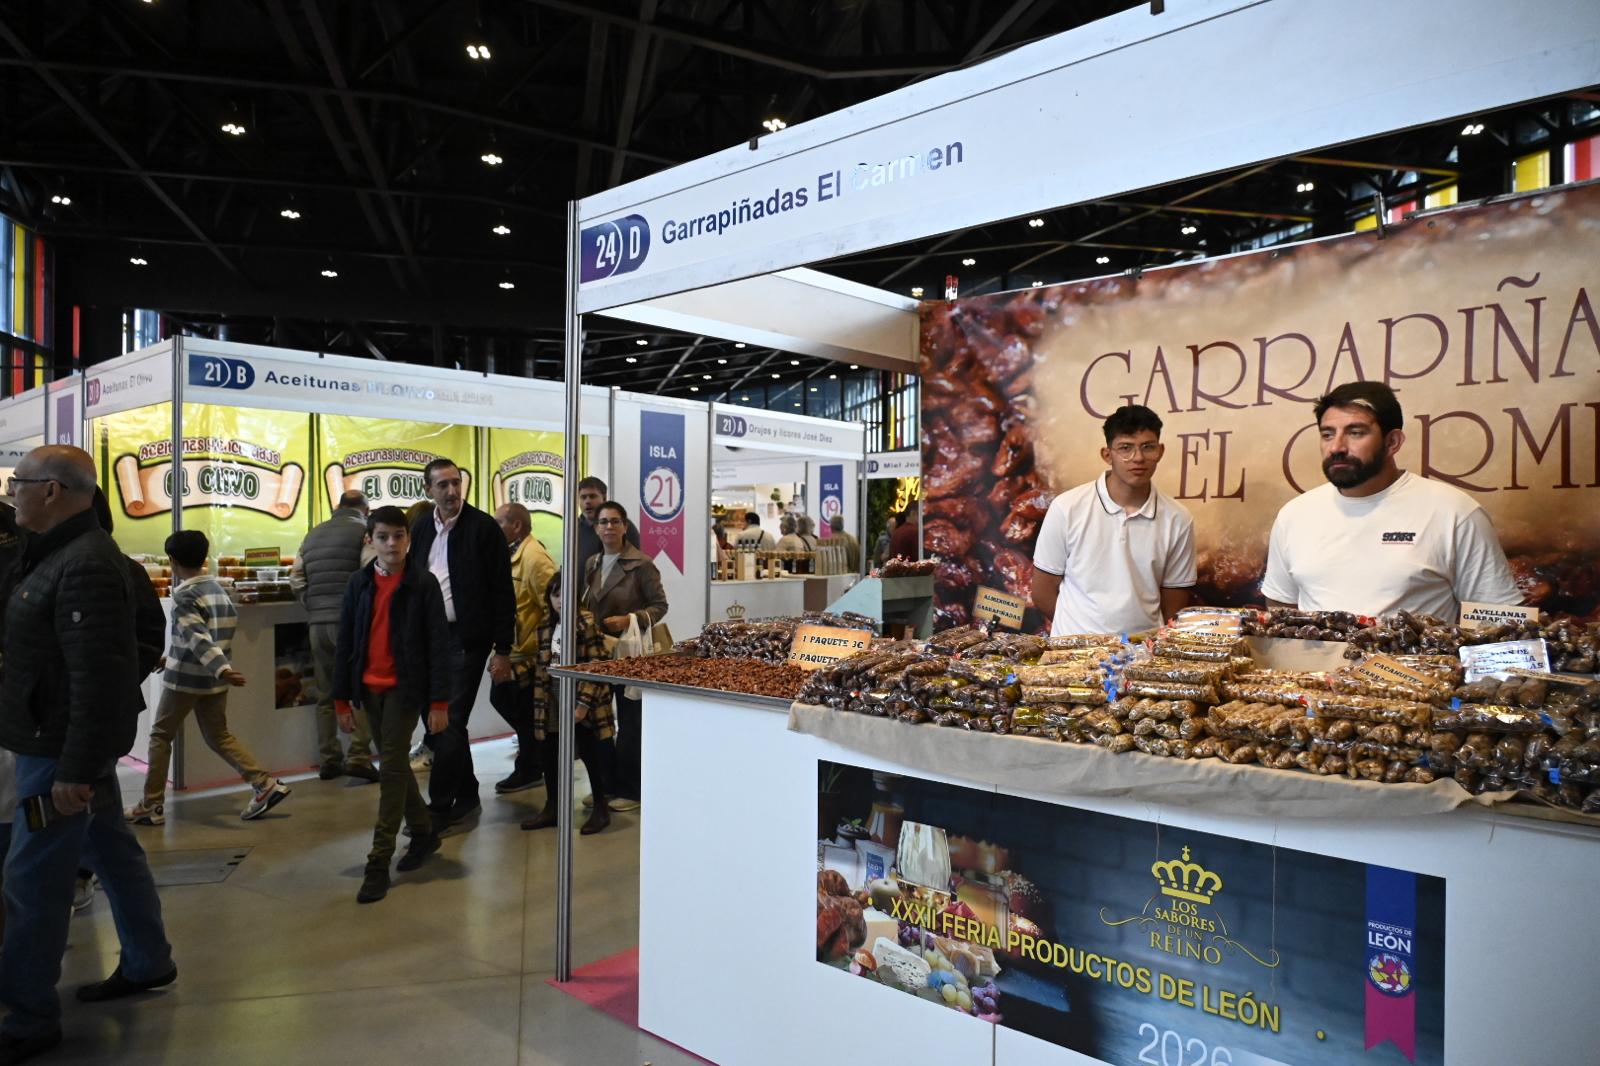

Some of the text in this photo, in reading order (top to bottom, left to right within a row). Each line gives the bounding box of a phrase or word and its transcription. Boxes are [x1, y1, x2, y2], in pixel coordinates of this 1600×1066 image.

[662, 141, 963, 245] Garrapiñadas El Carmen
[629, 224, 641, 251] D
[596, 232, 616, 269] 24
[204, 362, 221, 382] 21
[236, 365, 247, 384] B
[265, 371, 361, 392] Aceitunas
[722, 418, 732, 432] 21
[737, 421, 743, 434] A
[748, 423, 771, 435] Orujos
[344, 448, 393, 467] Aceitunas
[649, 445, 677, 459] ISLA
[1174, 429, 1246, 503] EL
[649, 475, 674, 508] 21
[824, 483, 839, 491] ISLA
[825, 499, 839, 516] 19
[1472, 608, 1527, 619] AVELLANAS
[809, 636, 848, 648] PAQUETE
[791, 652, 796, 660] 2
[1172, 899, 1198, 916] LOS
[1155, 907, 1215, 932] SABORES
[1368, 921, 1412, 937] PRODUCTOS DE
[1167, 924, 1202, 941] DE UN
[1151, 931, 1221, 965] REINO
[1368, 931, 1411, 954] LEÓN
[891, 896, 1279, 1033] XXXII FERIA PRODUCTOS DE LEÓN
